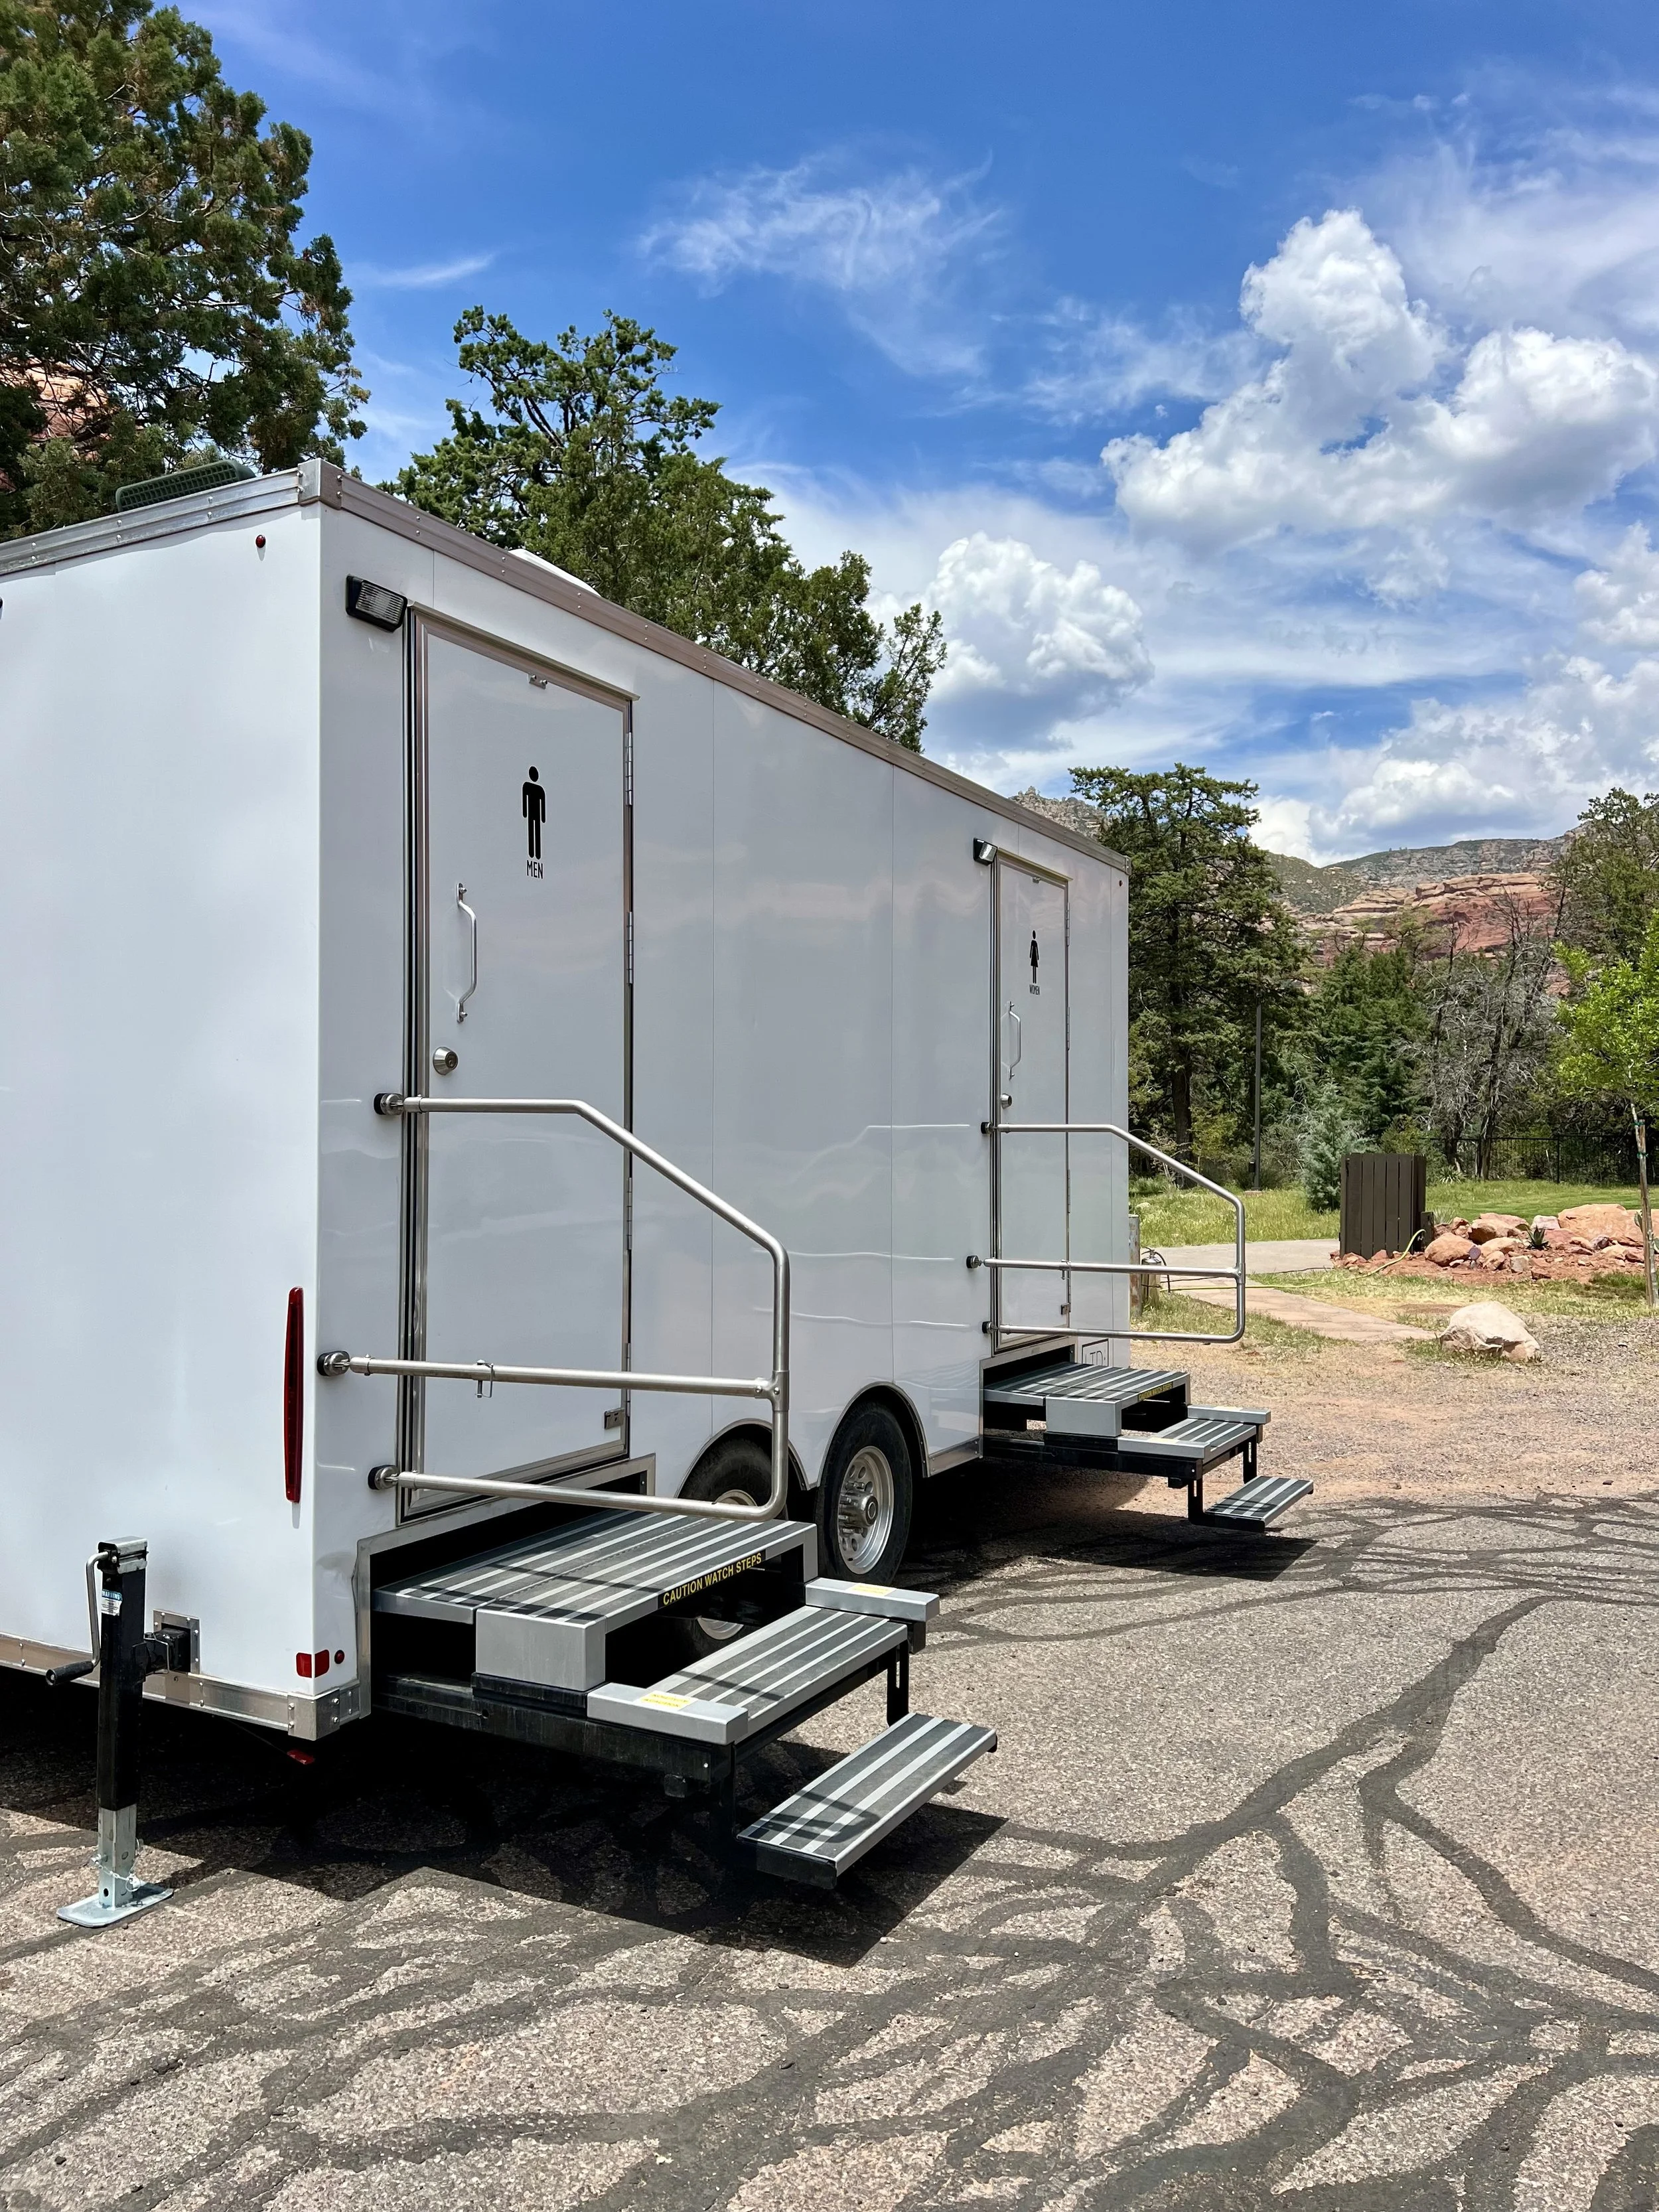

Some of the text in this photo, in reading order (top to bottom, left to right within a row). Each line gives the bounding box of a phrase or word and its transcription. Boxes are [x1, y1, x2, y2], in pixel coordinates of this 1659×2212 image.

[526, 859, 543, 879] MEN
[1029, 984, 1041, 995] WOMEN
[663, 1552, 762, 1605] CAUTION WATCH STEPS
